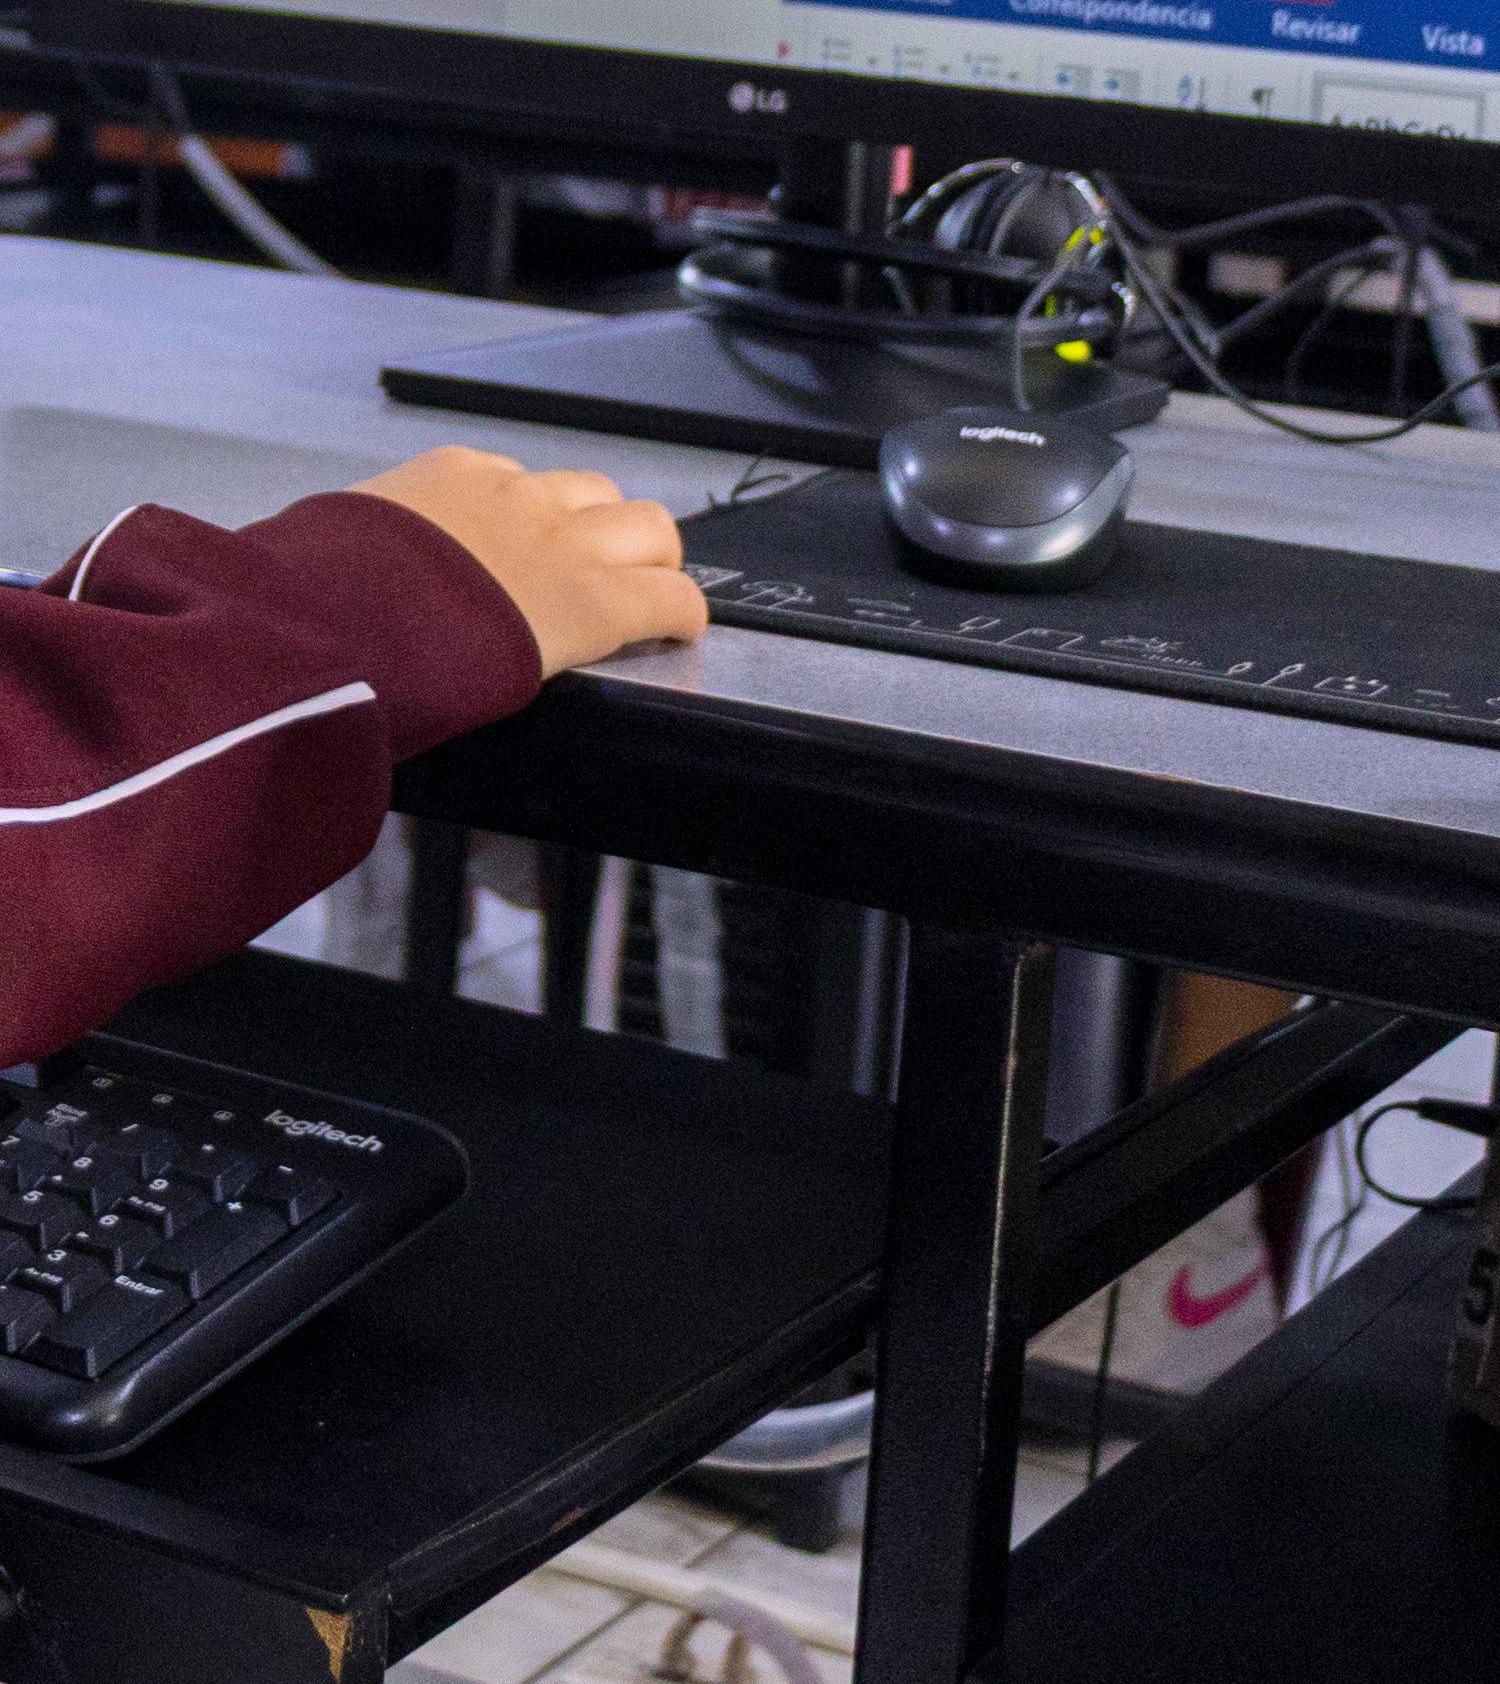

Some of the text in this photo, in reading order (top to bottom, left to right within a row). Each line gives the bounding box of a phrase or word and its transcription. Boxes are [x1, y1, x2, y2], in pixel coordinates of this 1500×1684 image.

[1270, 8, 1363, 46] Revisar
[1421, 21, 1488, 58] Vista
[959, 425, 1046, 447] logitech
[262, 1108, 385, 1154] logitech
